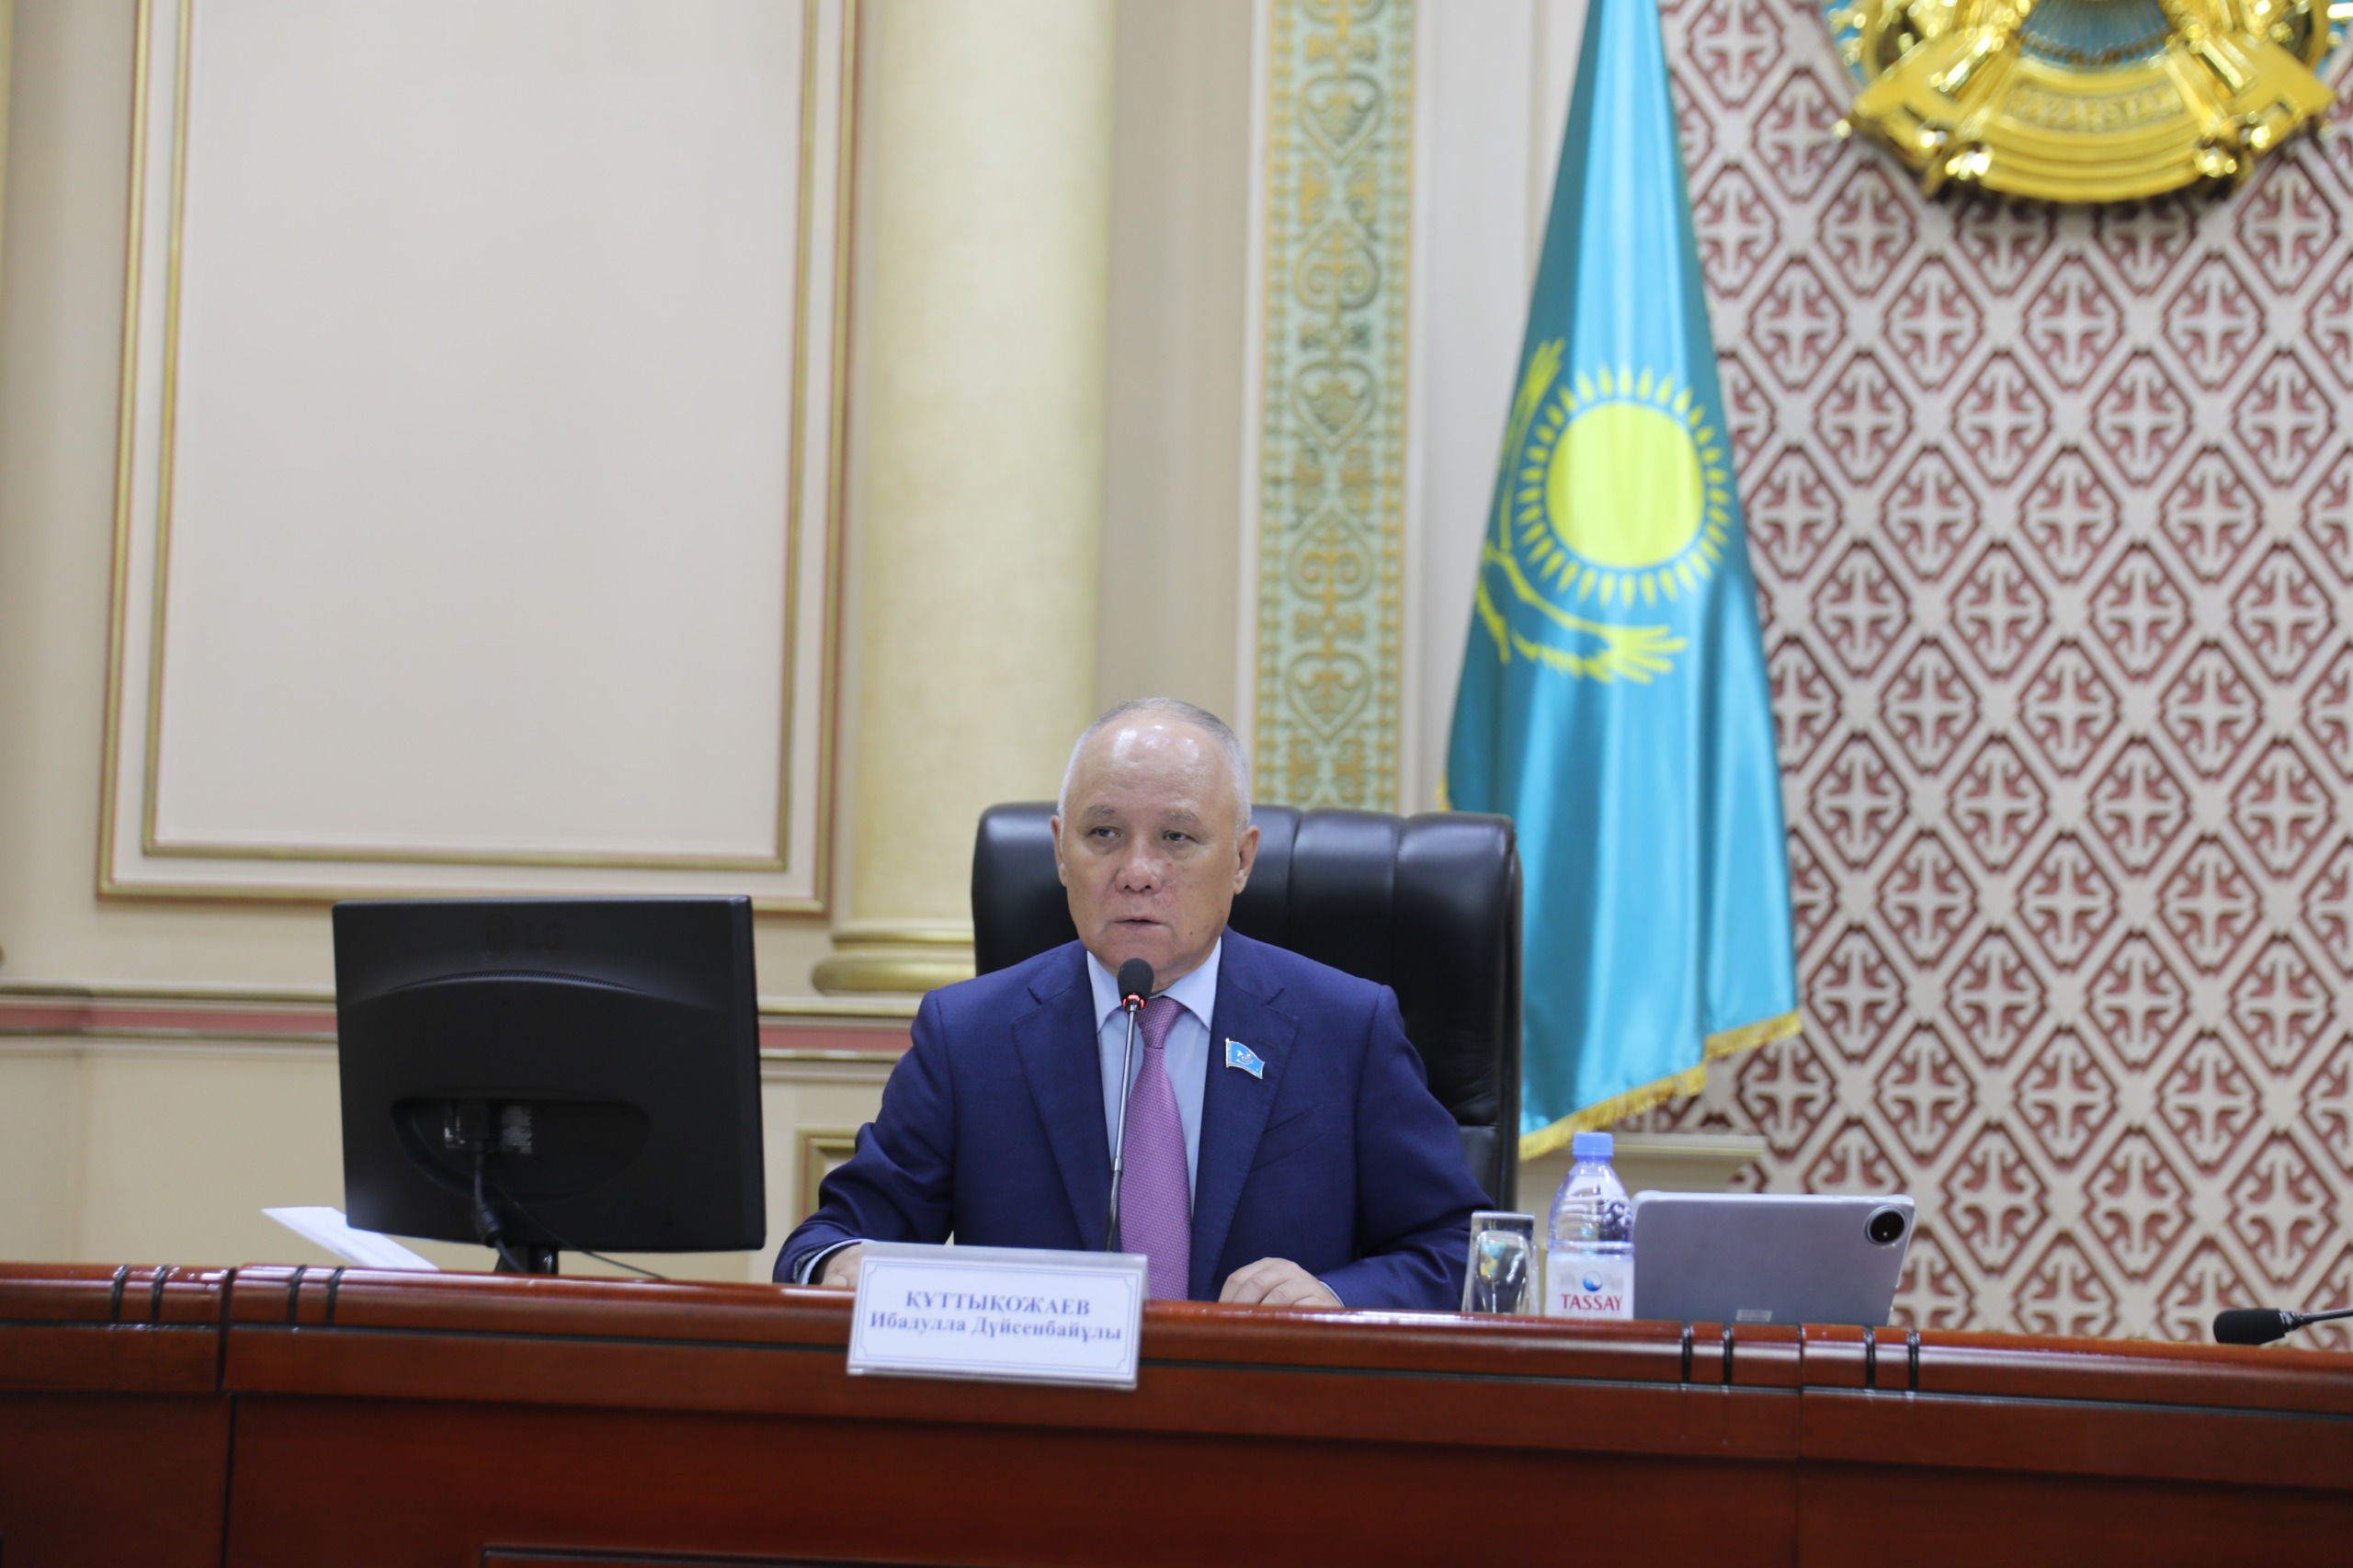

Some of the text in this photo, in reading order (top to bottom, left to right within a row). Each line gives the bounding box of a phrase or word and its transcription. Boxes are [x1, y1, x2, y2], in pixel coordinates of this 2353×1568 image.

[523, 921, 566, 951] LG
[1561, 1293, 1622, 1311] TASSAY
[870, 1311, 966, 1334] Ибадулла
